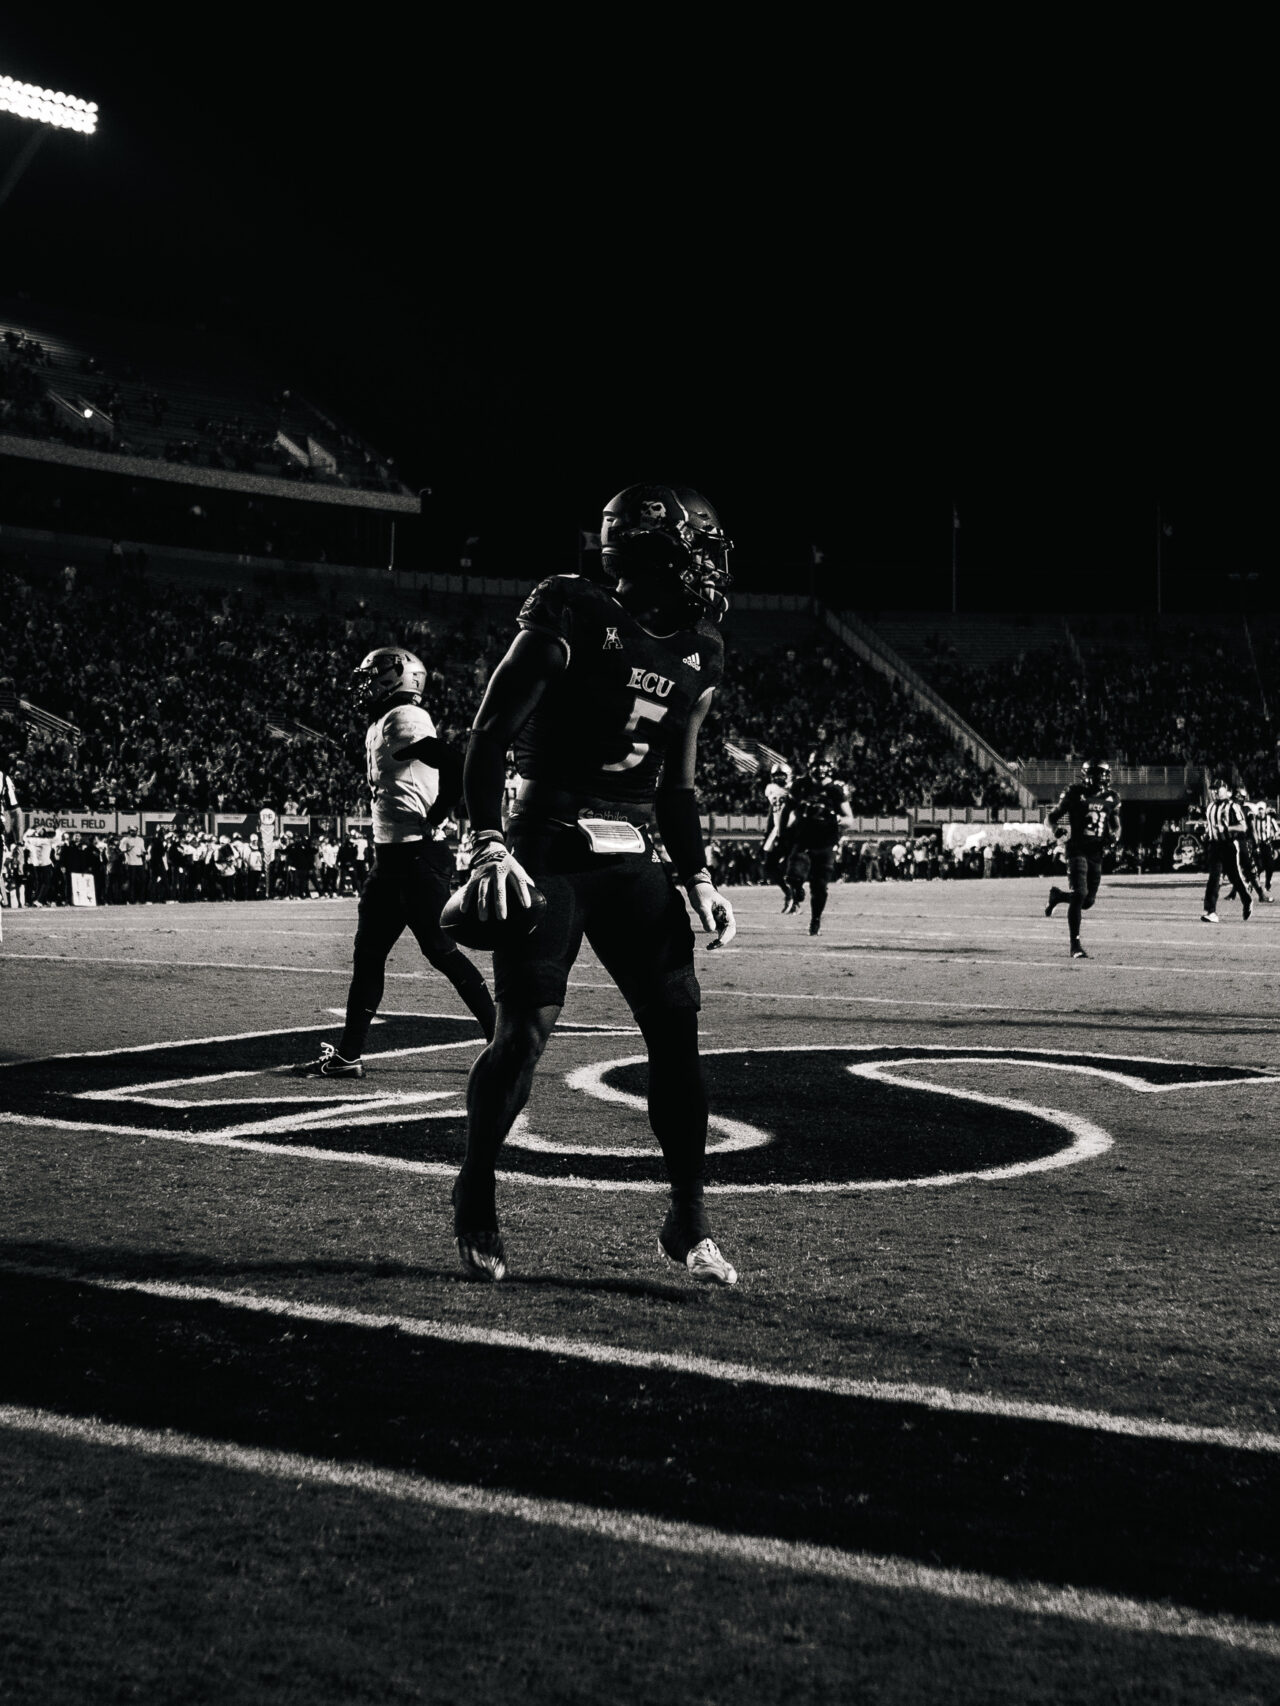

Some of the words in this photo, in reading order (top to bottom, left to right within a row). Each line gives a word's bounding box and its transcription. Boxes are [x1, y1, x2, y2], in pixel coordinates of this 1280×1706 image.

[626, 667, 676, 698] ECU
[601, 697, 669, 772] 5
[33, 818, 77, 829] BAGWELL
[81, 819, 106, 830] FIELD
